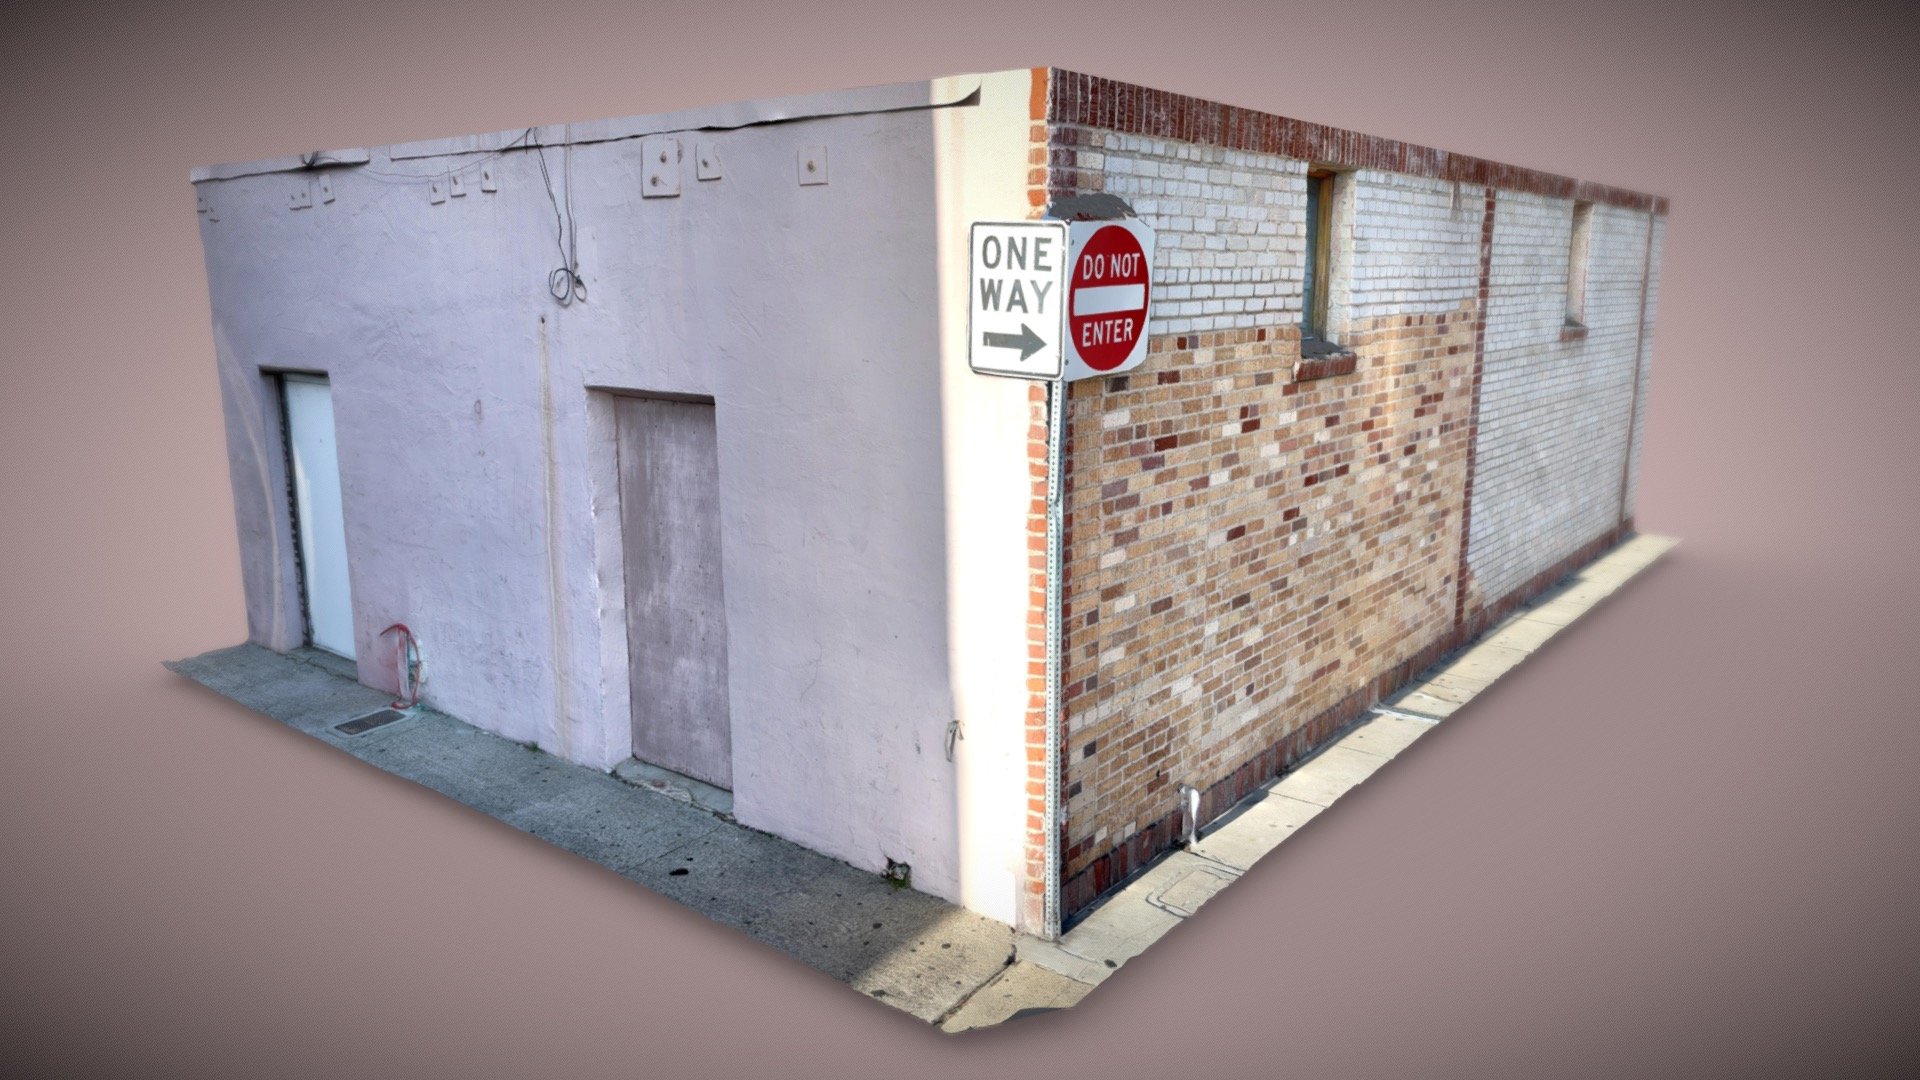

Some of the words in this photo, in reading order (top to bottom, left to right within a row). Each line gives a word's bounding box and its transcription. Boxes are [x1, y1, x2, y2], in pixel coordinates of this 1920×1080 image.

[982, 235, 1052, 271] ONE
[1082, 254, 1104, 280] DO
[1110, 253, 1140, 278] NOT
[979, 278, 1053, 314] WAY
[1082, 318, 1133, 347] ENTER
